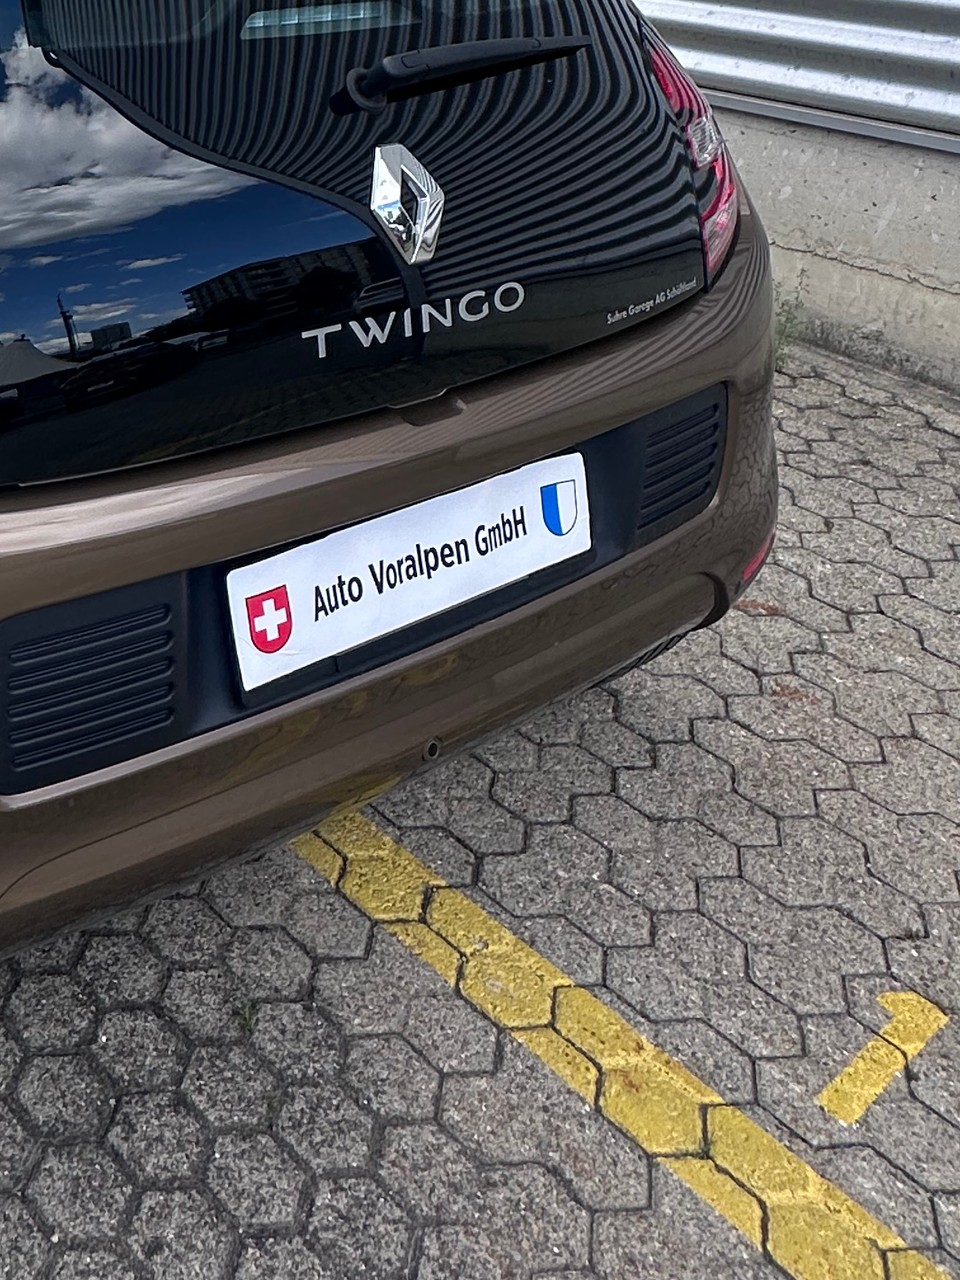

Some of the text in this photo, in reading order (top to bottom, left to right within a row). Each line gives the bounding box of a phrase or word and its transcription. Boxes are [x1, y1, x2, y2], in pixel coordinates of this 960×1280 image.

[301, 281, 525, 359] TWINGO
[628, 299, 654, 315] Garage
[655, 292, 666, 305] AG
[314, 506, 528, 623] Auto Voralpen GmbH
[815, 991, 950, 1126] 1
